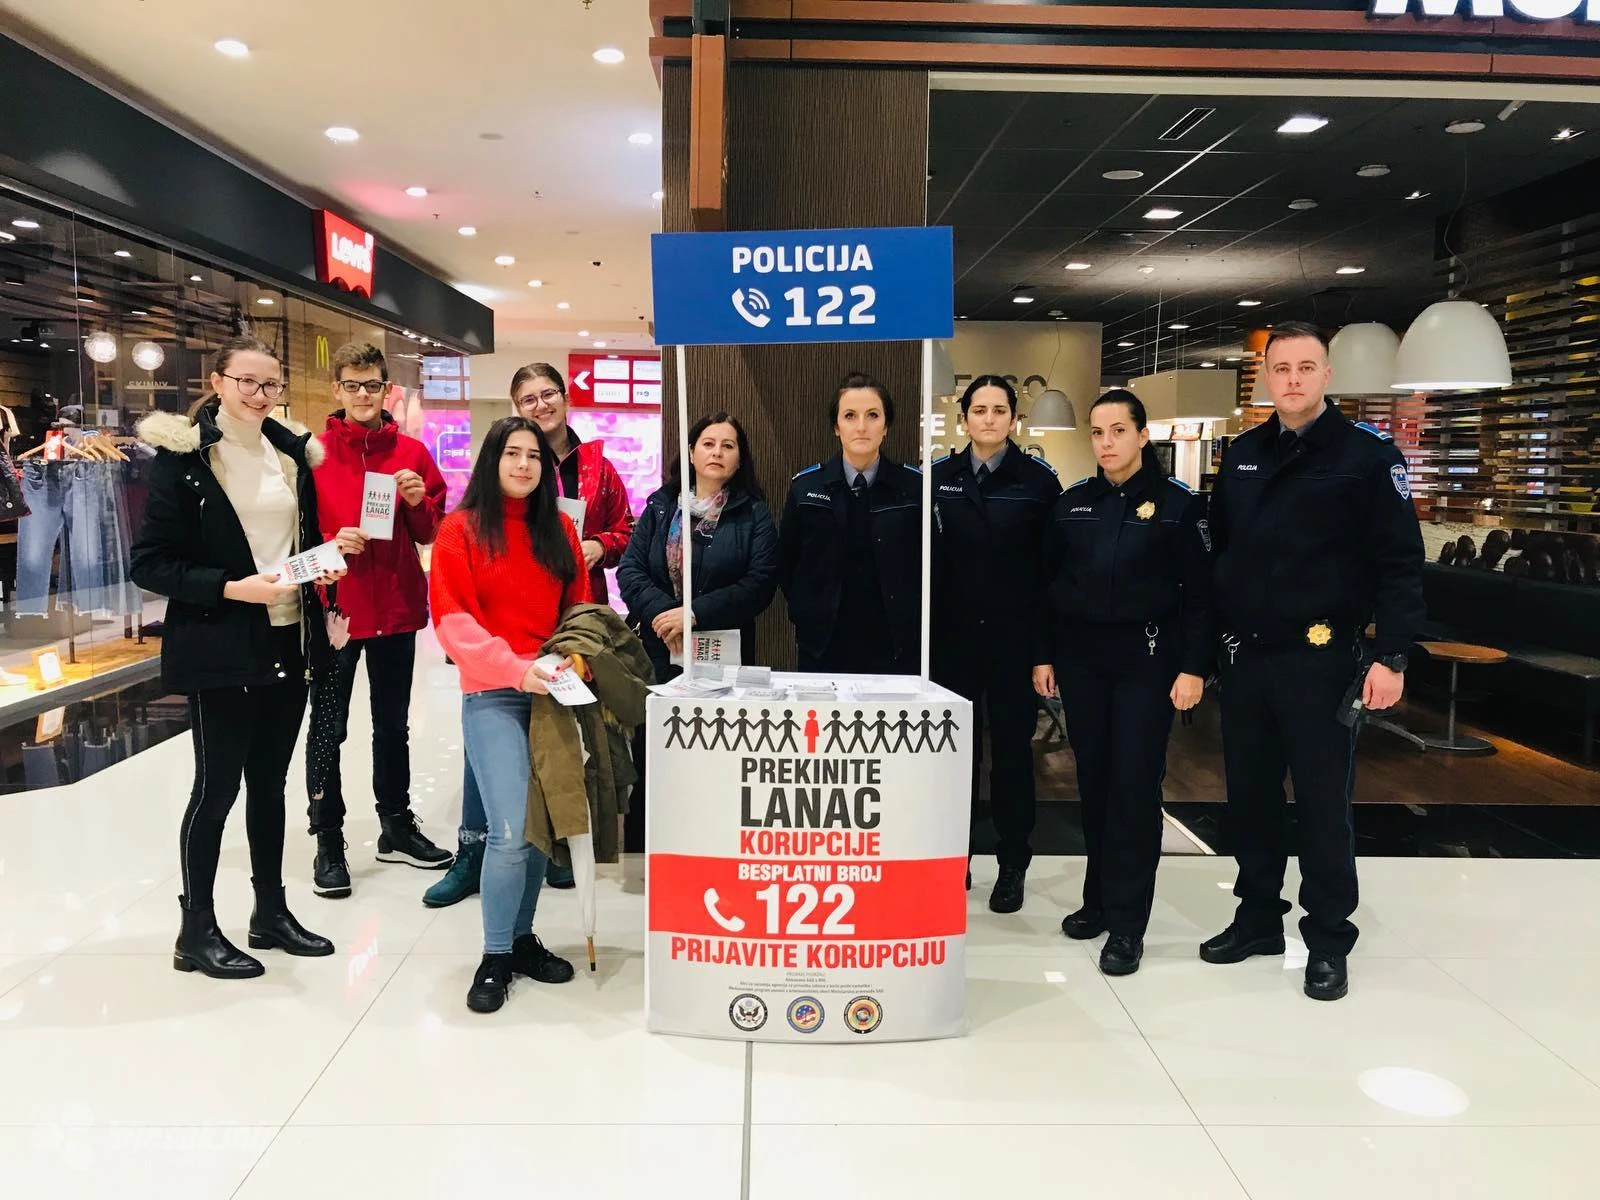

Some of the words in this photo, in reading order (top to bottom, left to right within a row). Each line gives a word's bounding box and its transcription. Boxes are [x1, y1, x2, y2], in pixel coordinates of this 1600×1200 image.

[732, 244, 874, 274] POLICIJA
[783, 284, 877, 326] 122
[806, 491, 832, 502] POLICIJA
[938, 484, 964, 493] POLICIJA
[366, 506, 390, 516] LANAC
[741, 757, 882, 784] PREKINITE
[740, 786, 881, 829] LANAC
[739, 830, 881, 856] KORUPCIJE
[738, 863, 832, 882] BESPLATNI
[836, 864, 882, 882] BROJ
[755, 883, 856, 935] 122
[671, 936, 798, 969] PRIJAVITE
[806, 939, 946, 970] KORUPCIJU
